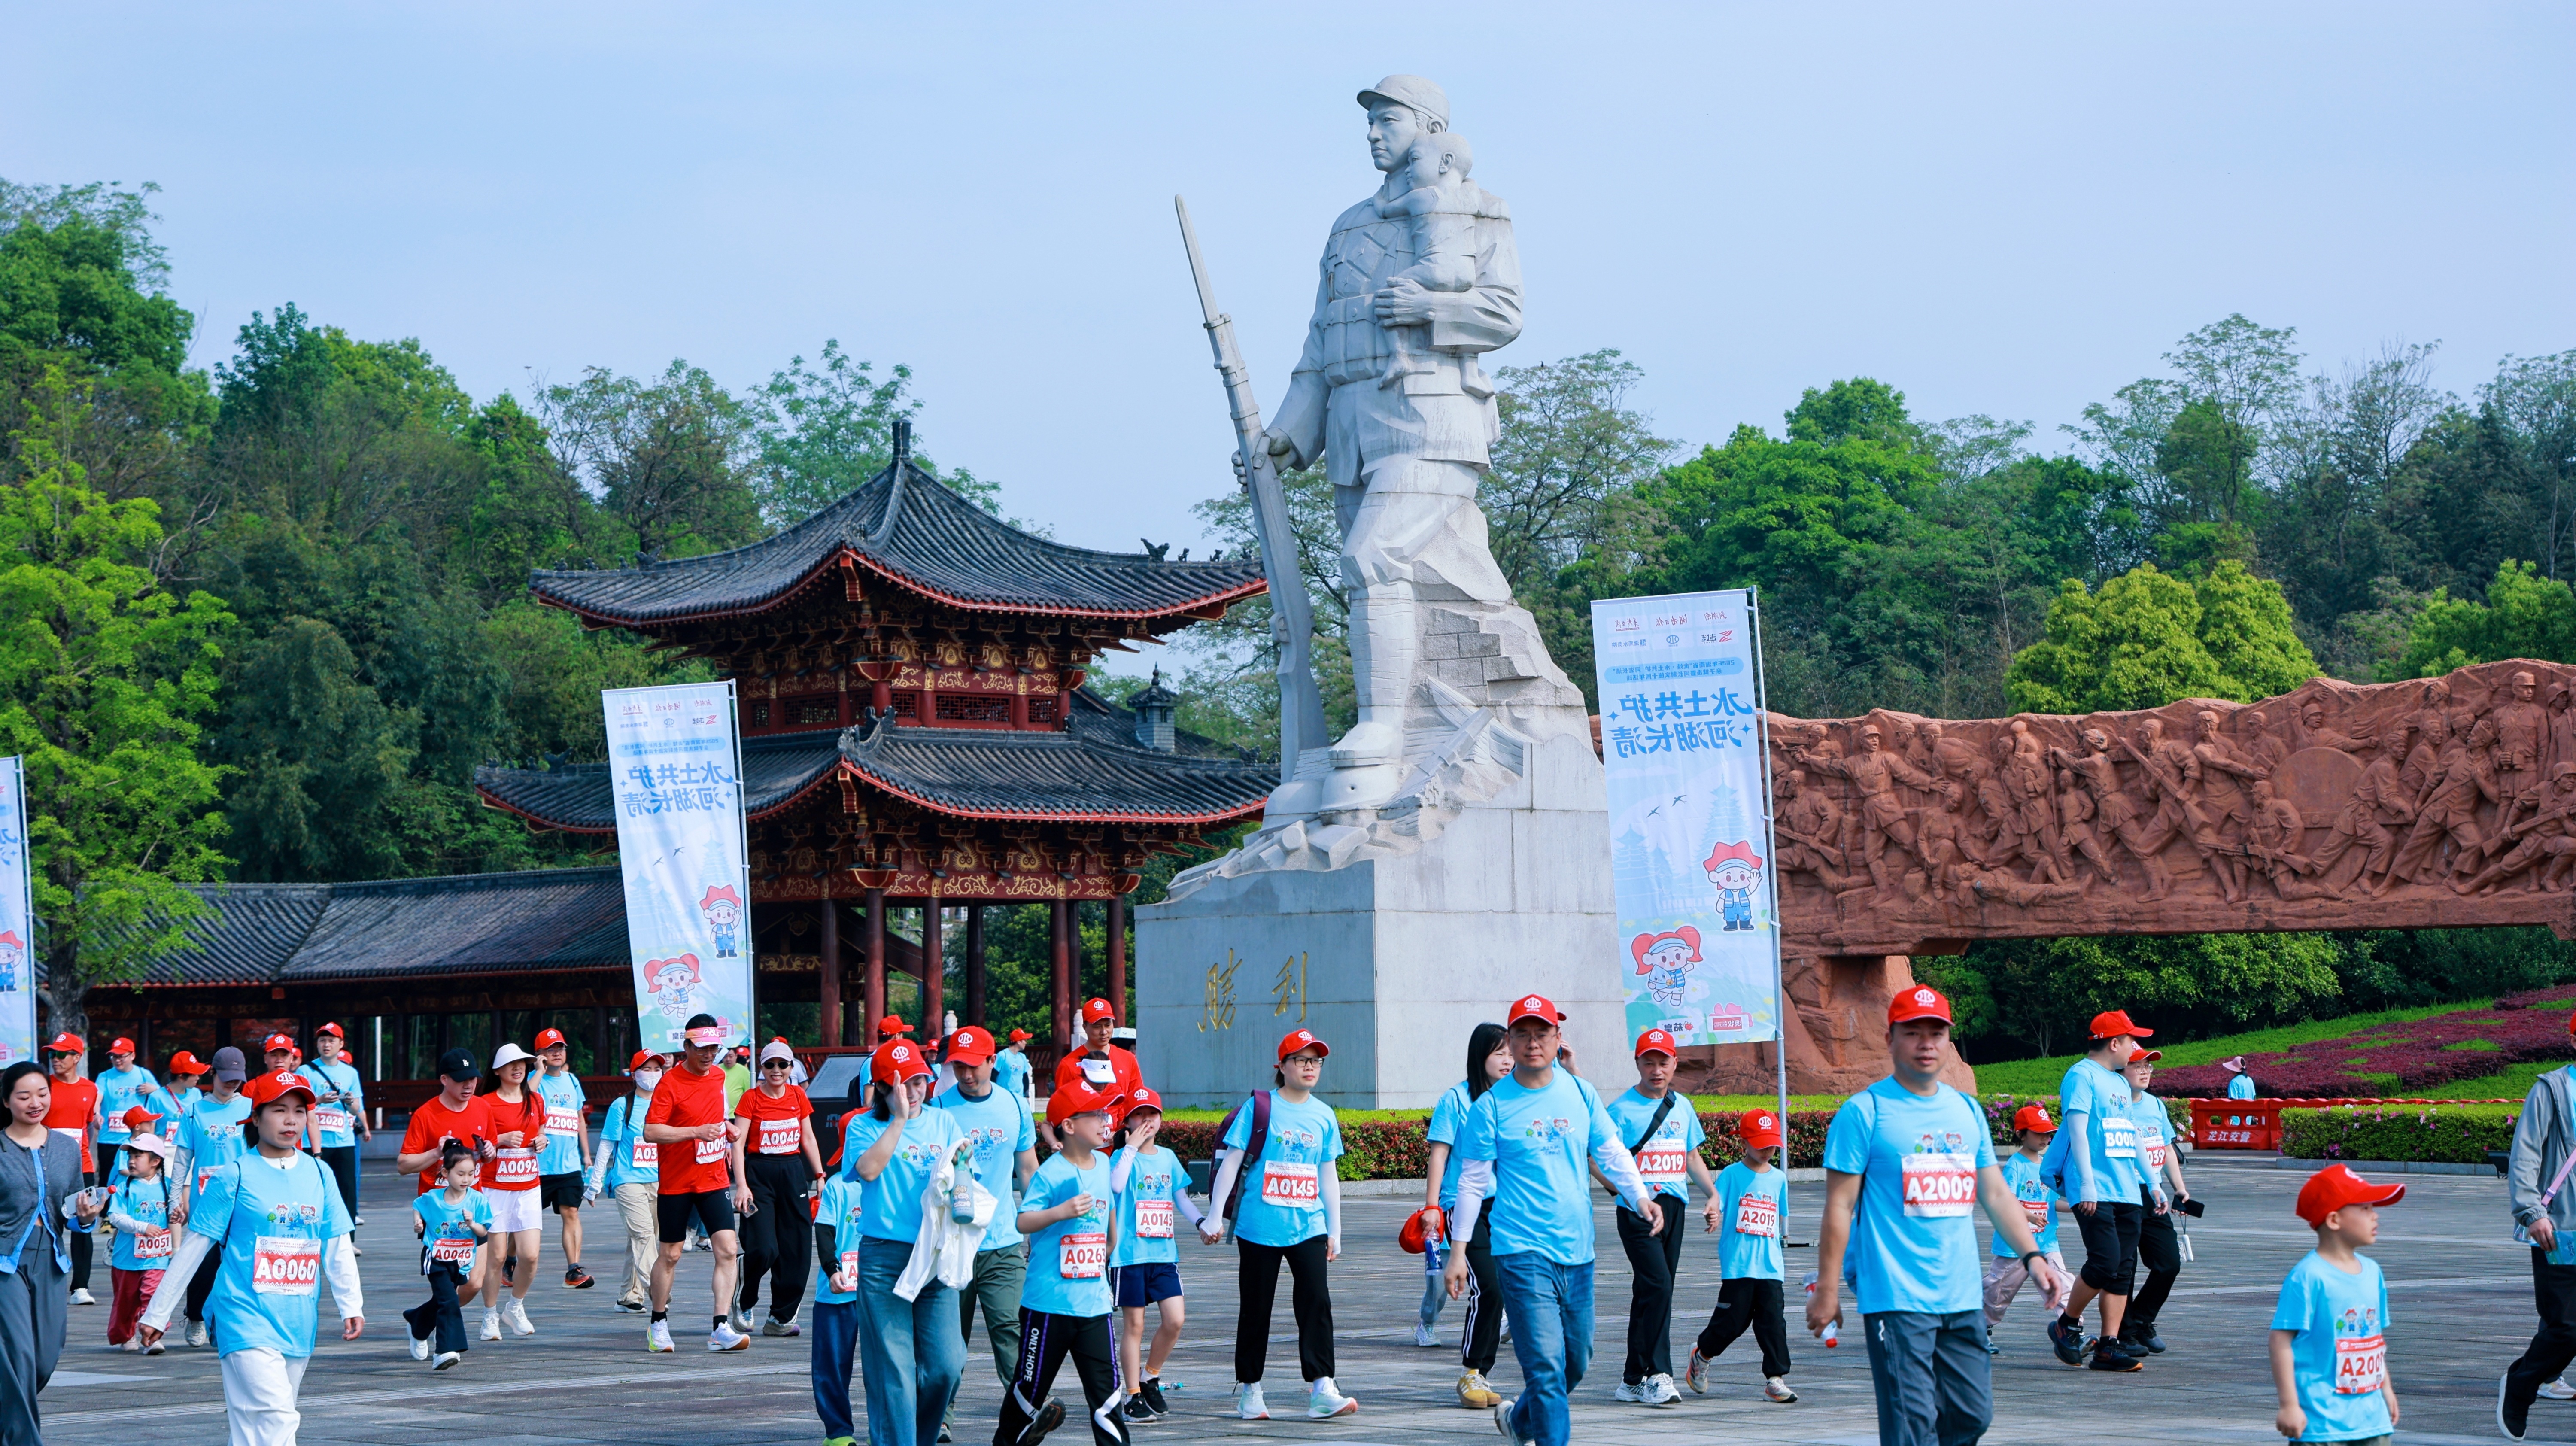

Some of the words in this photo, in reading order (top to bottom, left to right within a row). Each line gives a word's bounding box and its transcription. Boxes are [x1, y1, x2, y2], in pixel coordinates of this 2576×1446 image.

[546, 1116, 578, 1130] A2005
[761, 1129, 800, 1145] A0046
[2105, 1131, 2136, 1147] B008
[2207, 1130, 2251, 1142] 芷江交警
[497, 1159, 538, 1174] A0092
[1640, 1154, 1683, 1171] A2019
[1266, 1177, 1315, 1197] A0145
[1906, 1176, 1975, 1201] A2009
[1140, 1213, 1172, 1227] A0145
[1741, 1210, 1775, 1227] A2019
[139, 1236, 170, 1249] A0051
[434, 1249, 471, 1260] A0046
[255, 1258, 316, 1281] A0060
[1024, 1328, 1039, 1382] ONLY:HOPE
